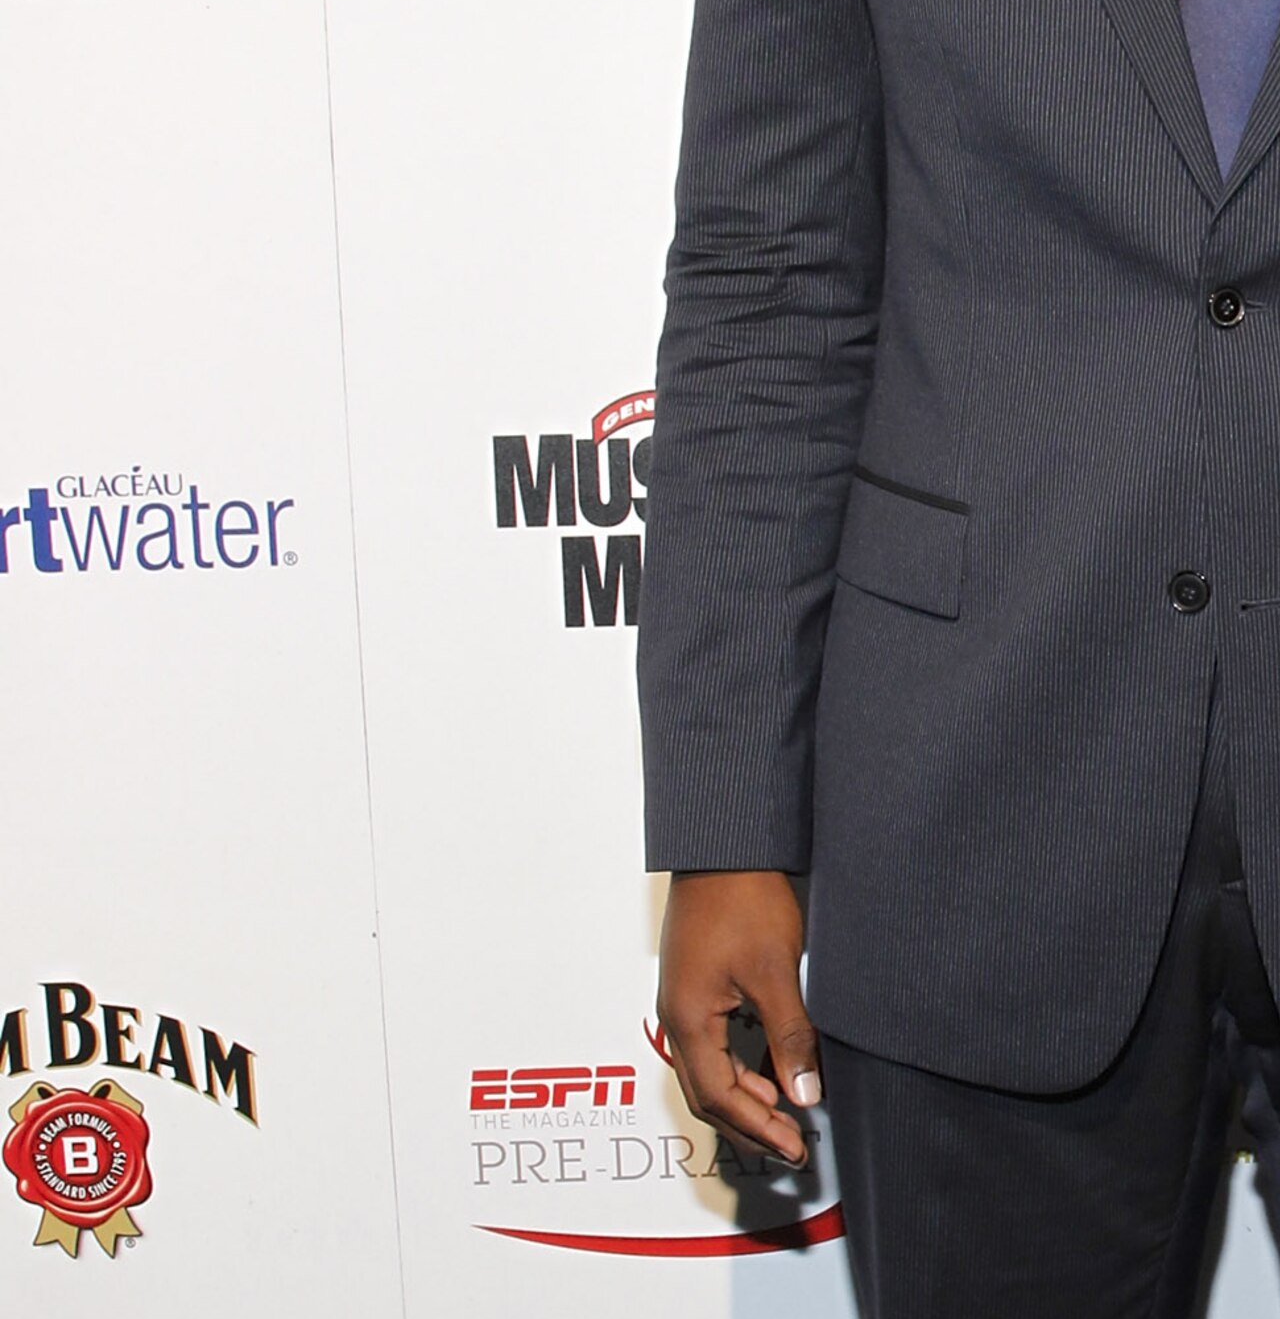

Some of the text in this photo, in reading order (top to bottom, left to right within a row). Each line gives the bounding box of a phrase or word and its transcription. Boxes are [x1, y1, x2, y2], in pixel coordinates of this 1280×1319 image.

[57, 465, 183, 498] GLACÉAU
[38, 982, 260, 1129] BEAM
[470, 1065, 636, 1110] ESPN
[40, 1113, 117, 1143] BEAM FORMULA
[470, 1110, 637, 1130] THE MAGAZINE
[62, 1136, 98, 1175] B
[37, 1162, 87, 1199] STANDARD
[89, 1173, 118, 1198] SINCE
[111, 1152, 127, 1175] 1795
